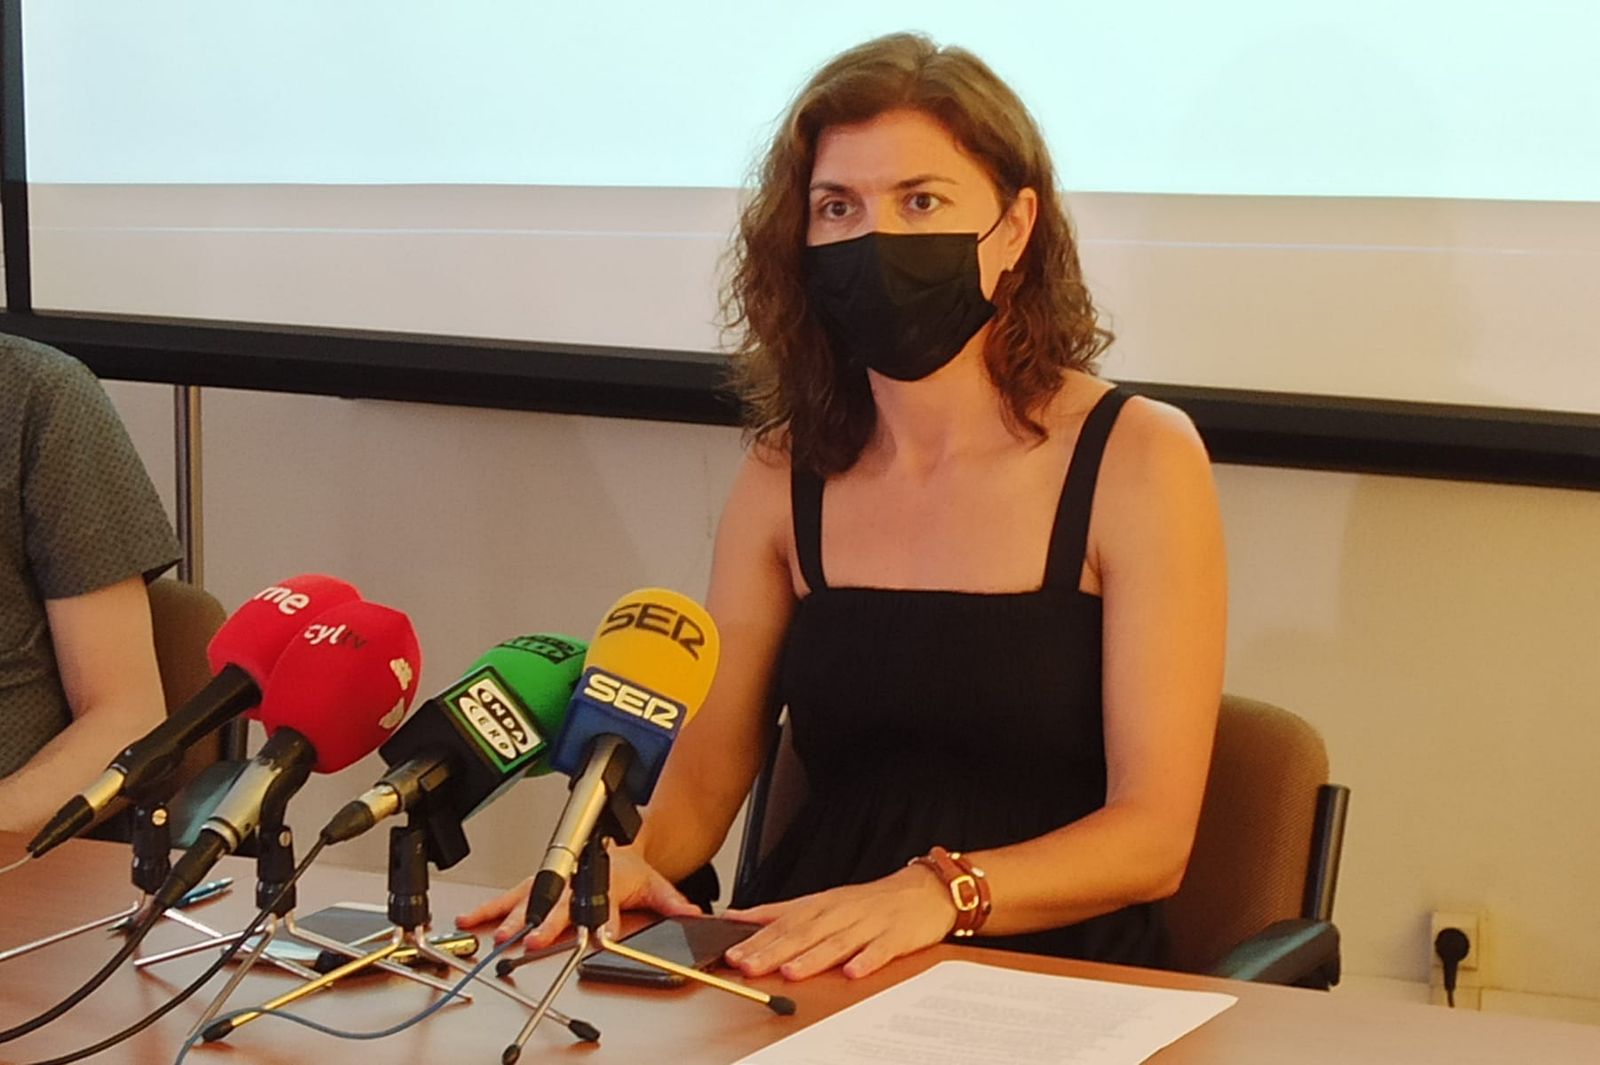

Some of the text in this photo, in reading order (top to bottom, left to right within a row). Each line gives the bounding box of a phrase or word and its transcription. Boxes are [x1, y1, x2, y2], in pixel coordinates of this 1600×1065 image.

[600, 602, 705, 661] SER
[468, 704, 510, 750] CERO
[480, 691, 525, 742] ONDA
[583, 673, 680, 730] SER
